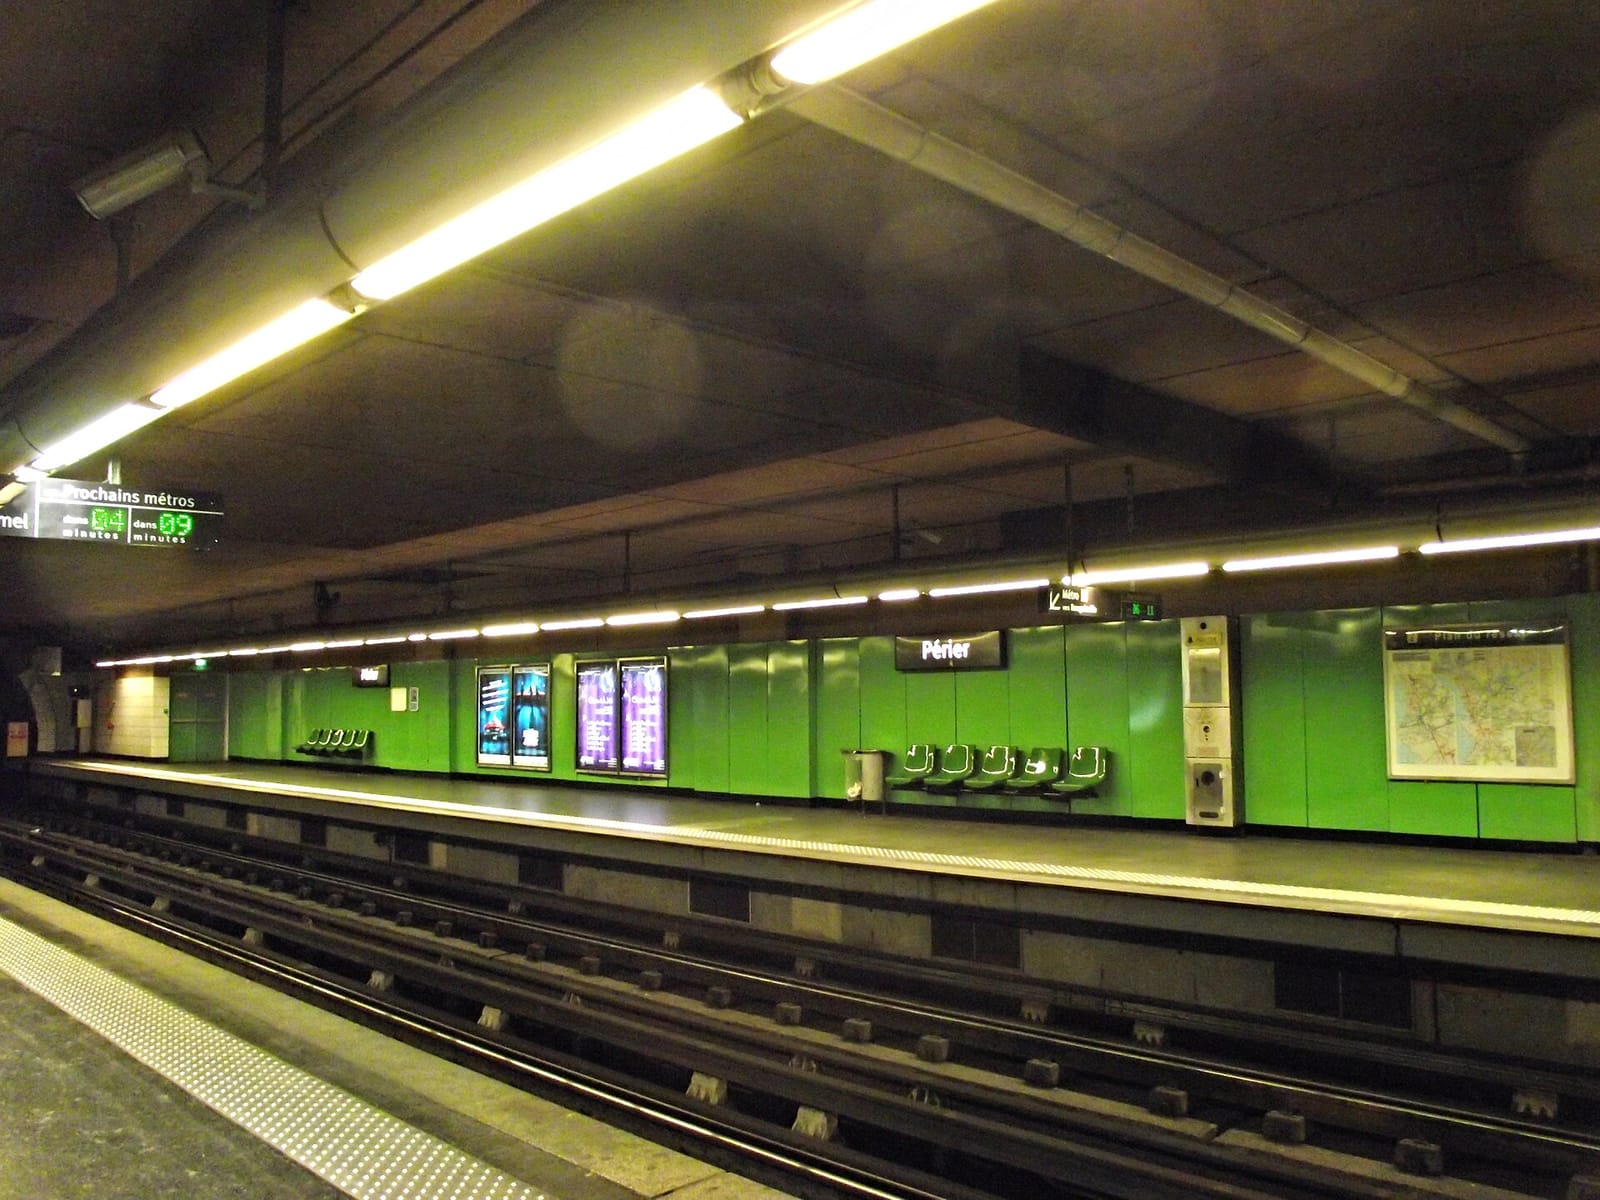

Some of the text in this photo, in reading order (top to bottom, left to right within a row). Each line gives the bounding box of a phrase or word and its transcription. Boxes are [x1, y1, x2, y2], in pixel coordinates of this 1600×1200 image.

[63, 483, 195, 508] Prochains métros
[133, 519, 157, 529] dans
[159, 513, 192, 536] 09
[62, 528, 119, 540] minutes
[133, 533, 186, 544] minutes
[922, 638, 970, 660] Périer
